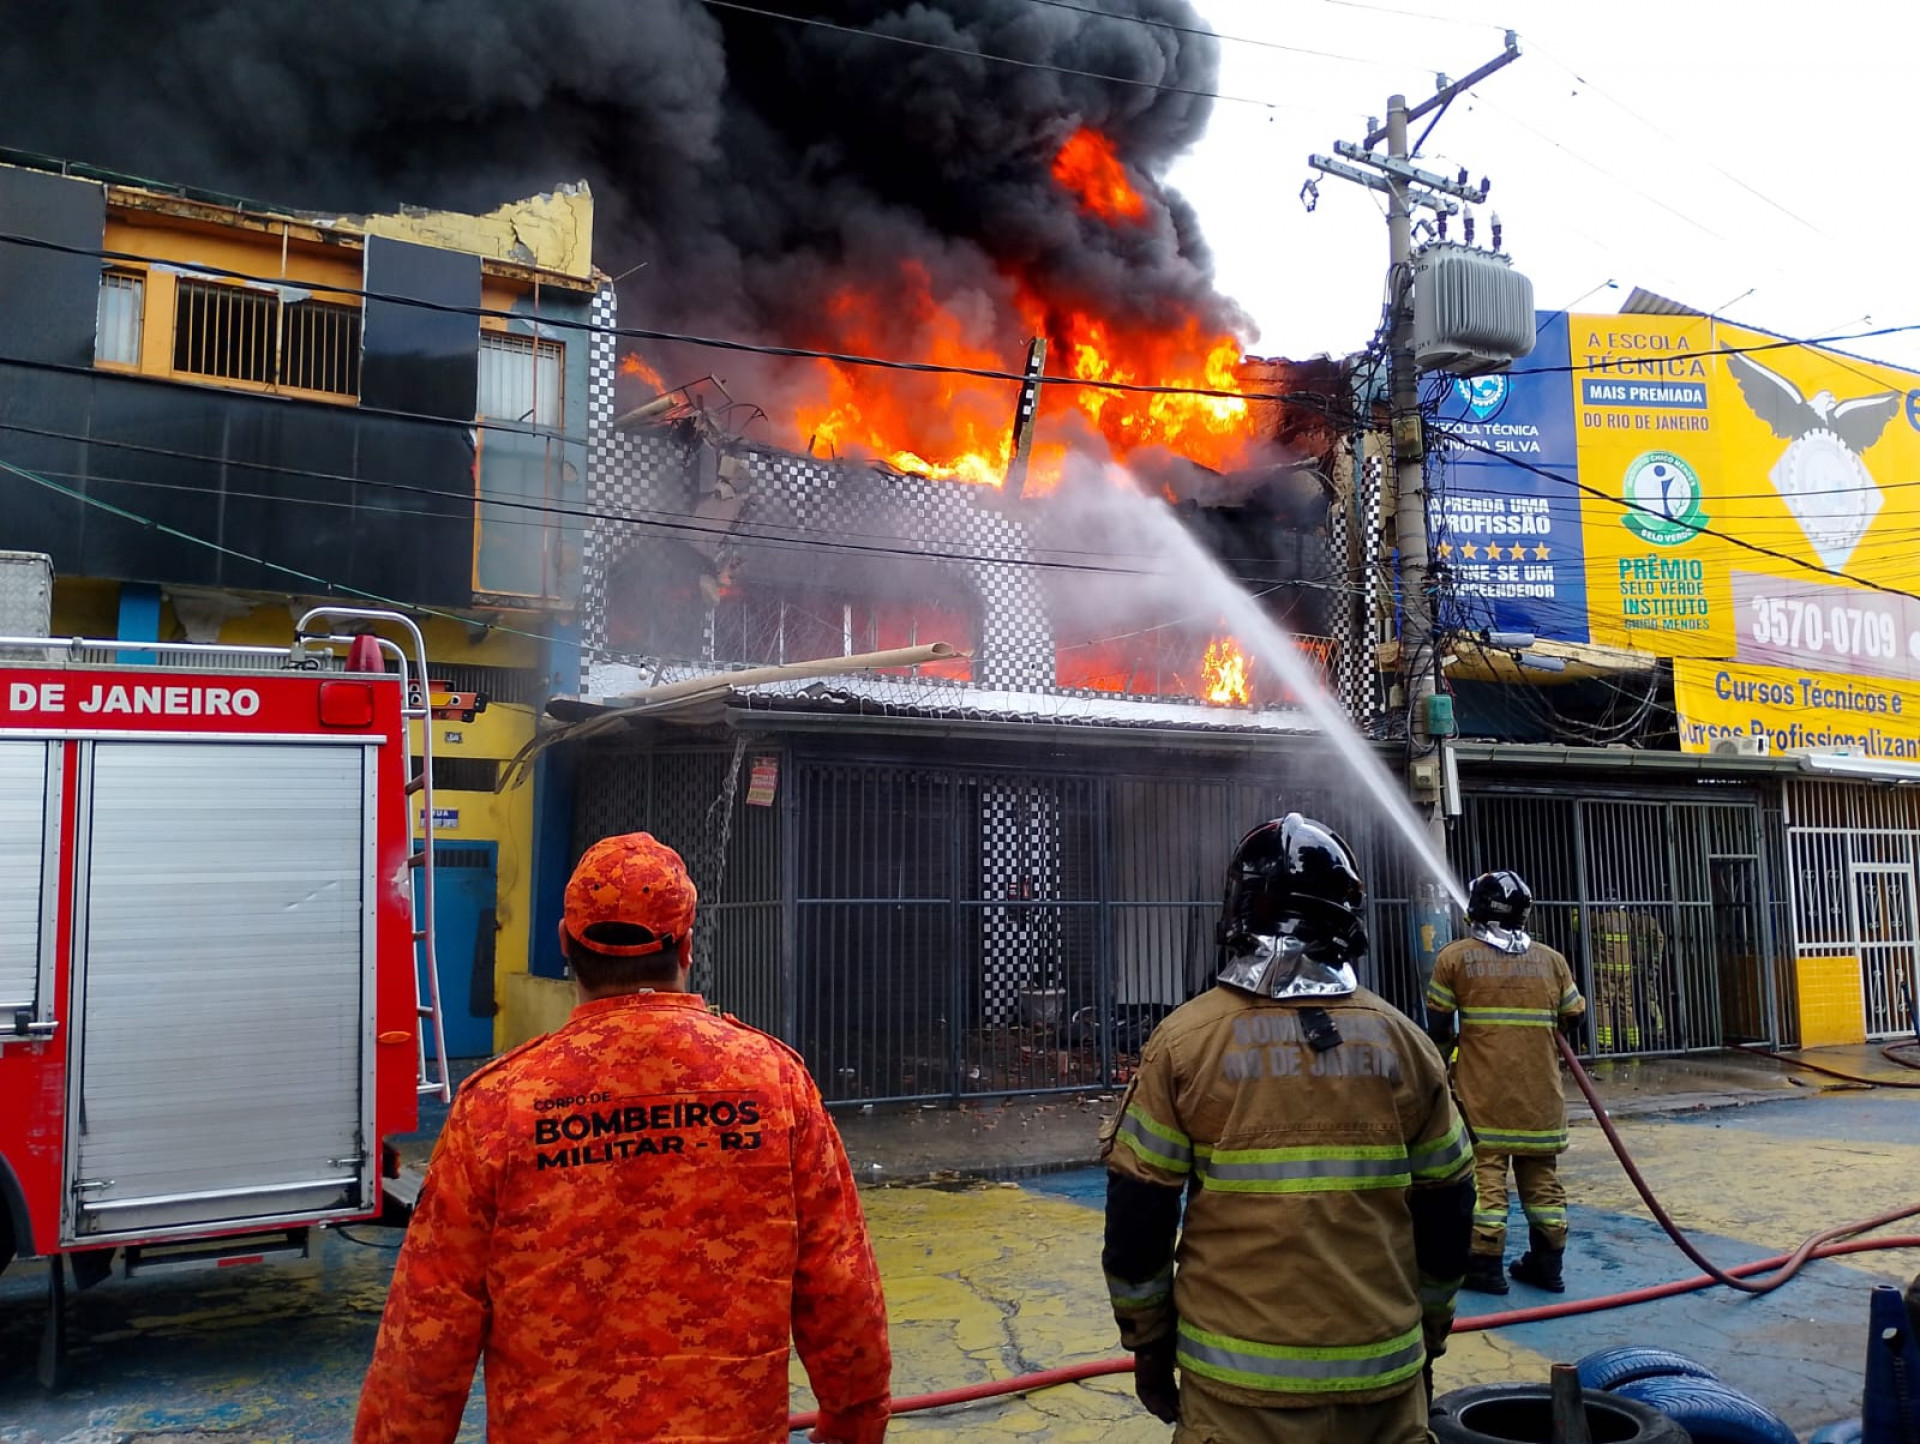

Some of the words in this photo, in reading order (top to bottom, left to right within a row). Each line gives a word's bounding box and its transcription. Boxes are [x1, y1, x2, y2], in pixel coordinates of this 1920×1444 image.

[1588, 332, 1601, 347] A
[1608, 332, 1690, 350] ESCOLA
[1583, 351, 1705, 377] TÉCNICA
[1590, 385, 1626, 399] MAIS
[1630, 387, 1703, 402] PREMIADA
[1483, 423, 1539, 436] TÉCNICA
[1584, 412, 1602, 428] DO
[1607, 413, 1630, 429] RIO
[1635, 414, 1651, 429] DE
[1656, 415, 1709, 431] JANEIRO
[1495, 441, 1540, 452] SILVA
[1430, 497, 1505, 513] APRENDA
[1510, 498, 1550, 513] UMA
[1430, 512, 1551, 534] PROFISSÃO
[1523, 565, 1554, 581] UM
[1619, 553, 1702, 580] PRÊMIO
[1620, 582, 1654, 595] SELO
[1660, 582, 1703, 595] VERDE
[1623, 598, 1708, 615] INSTITUTO
[1662, 619, 1709, 630] MENDES
[1751, 595, 1897, 658] 3570-0709
[9, 683, 65, 712] DE
[79, 685, 260, 716] JANEIRO
[1715, 671, 1795, 705] Cursos
[1798, 678, 1887, 714] Técnicos
[1892, 693, 1902, 713] e
[1270, 1047, 1303, 1076] DE
[533, 1094, 587, 1111] CORPO
[590, 1091, 611, 1104] DE
[535, 1100, 760, 1145] BOMBEIROS
[537, 1136, 685, 1170] MILITAR
[720, 1131, 762, 1151] RJ
